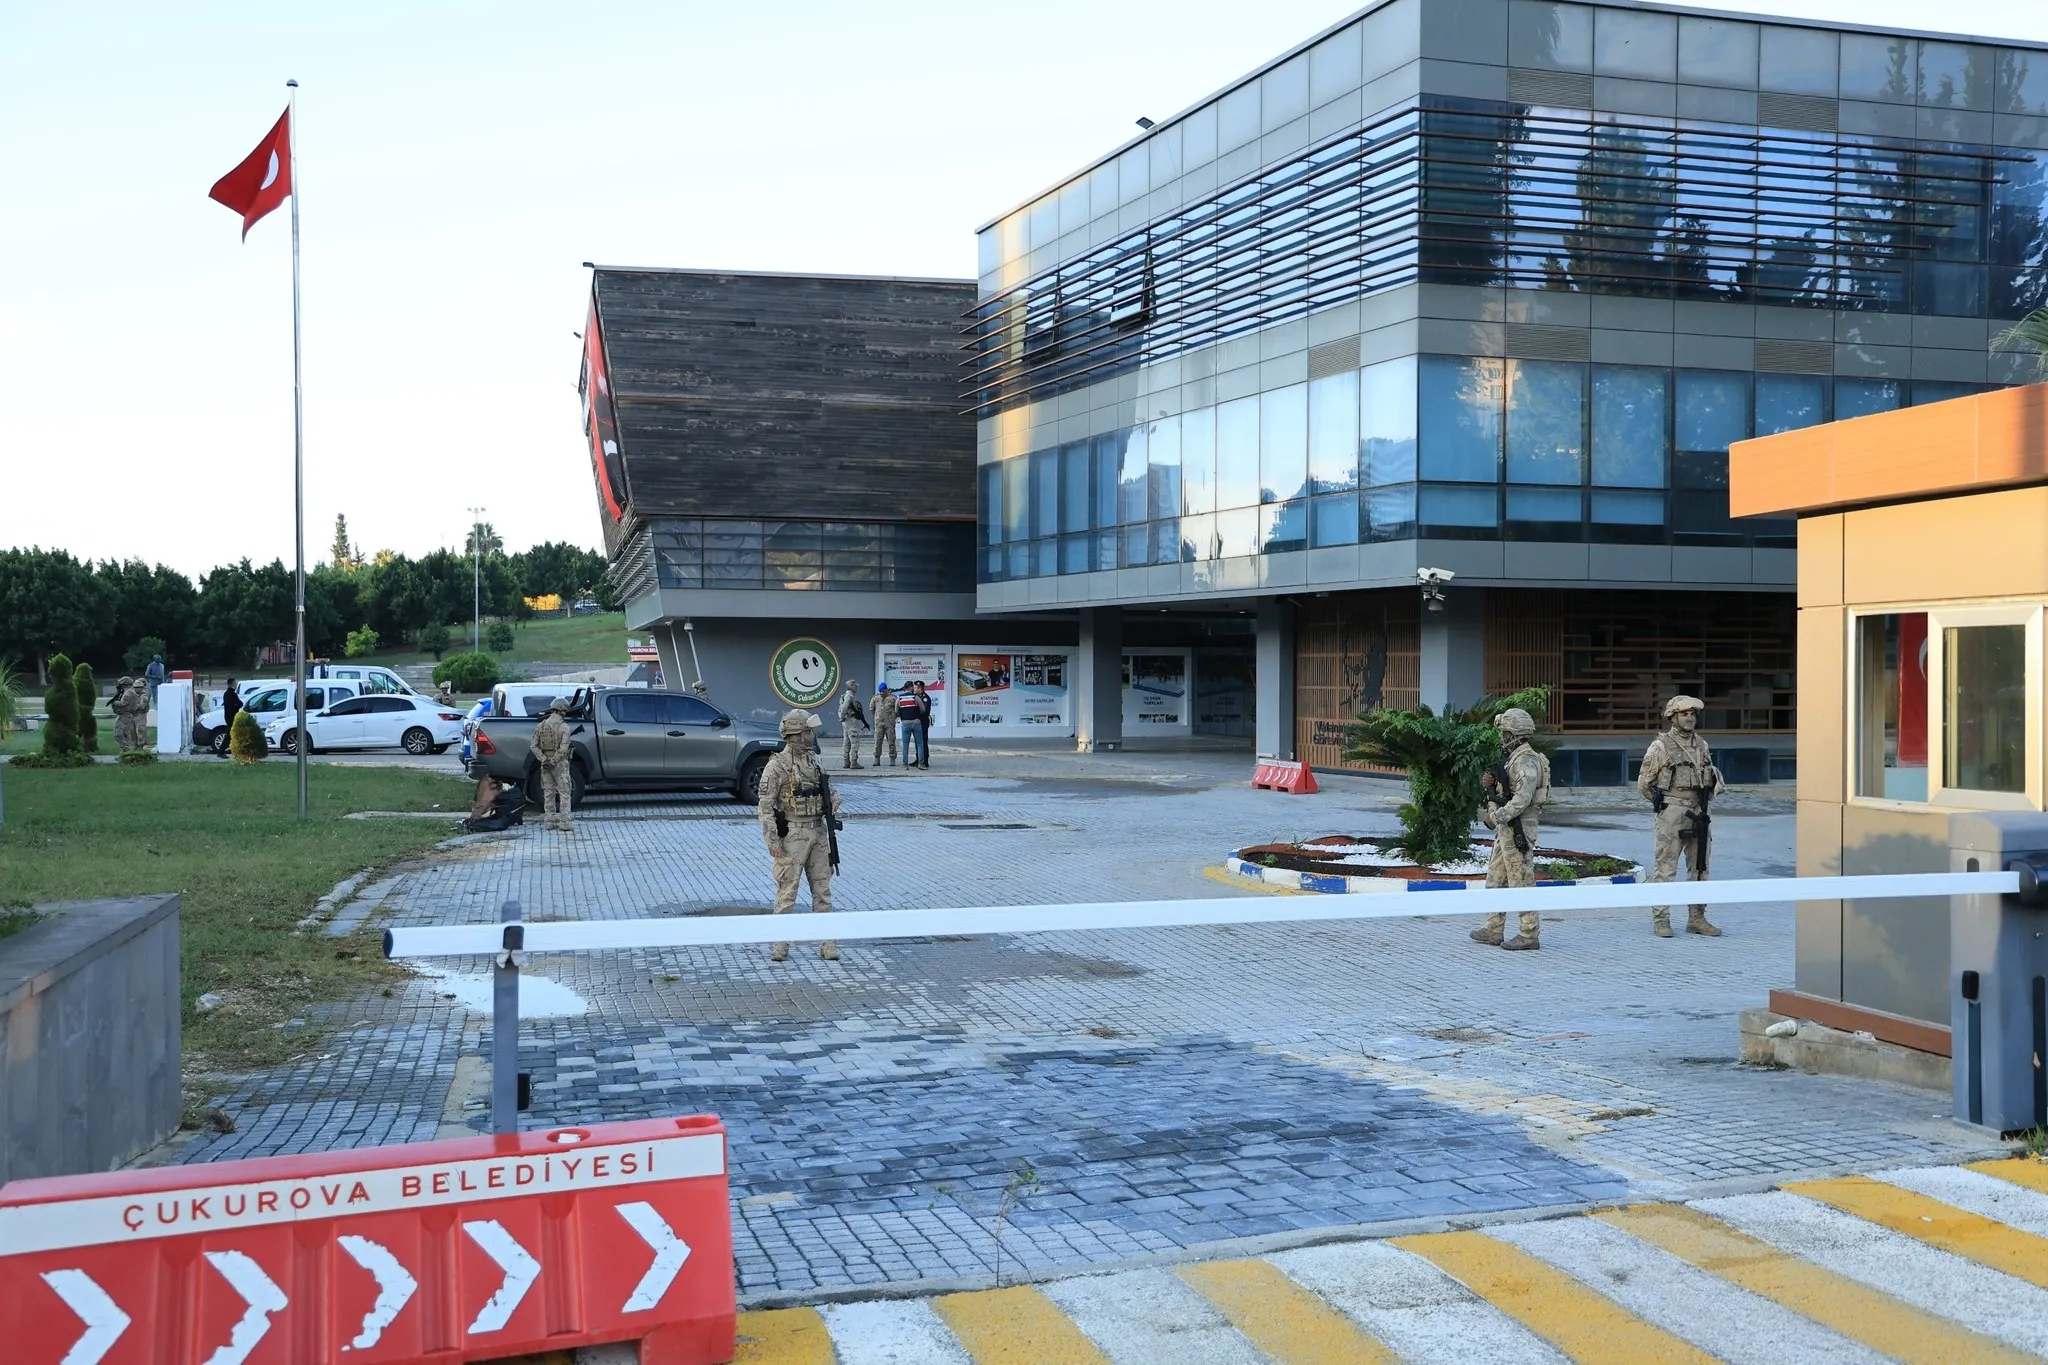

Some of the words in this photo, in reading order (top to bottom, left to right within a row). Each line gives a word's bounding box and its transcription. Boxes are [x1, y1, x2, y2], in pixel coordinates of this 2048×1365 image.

[776, 665, 796, 698] Gülümseyin
[123, 1181, 371, 1231] ÇUKUROVA
[402, 1147, 654, 1197] BELEDİYESİ
